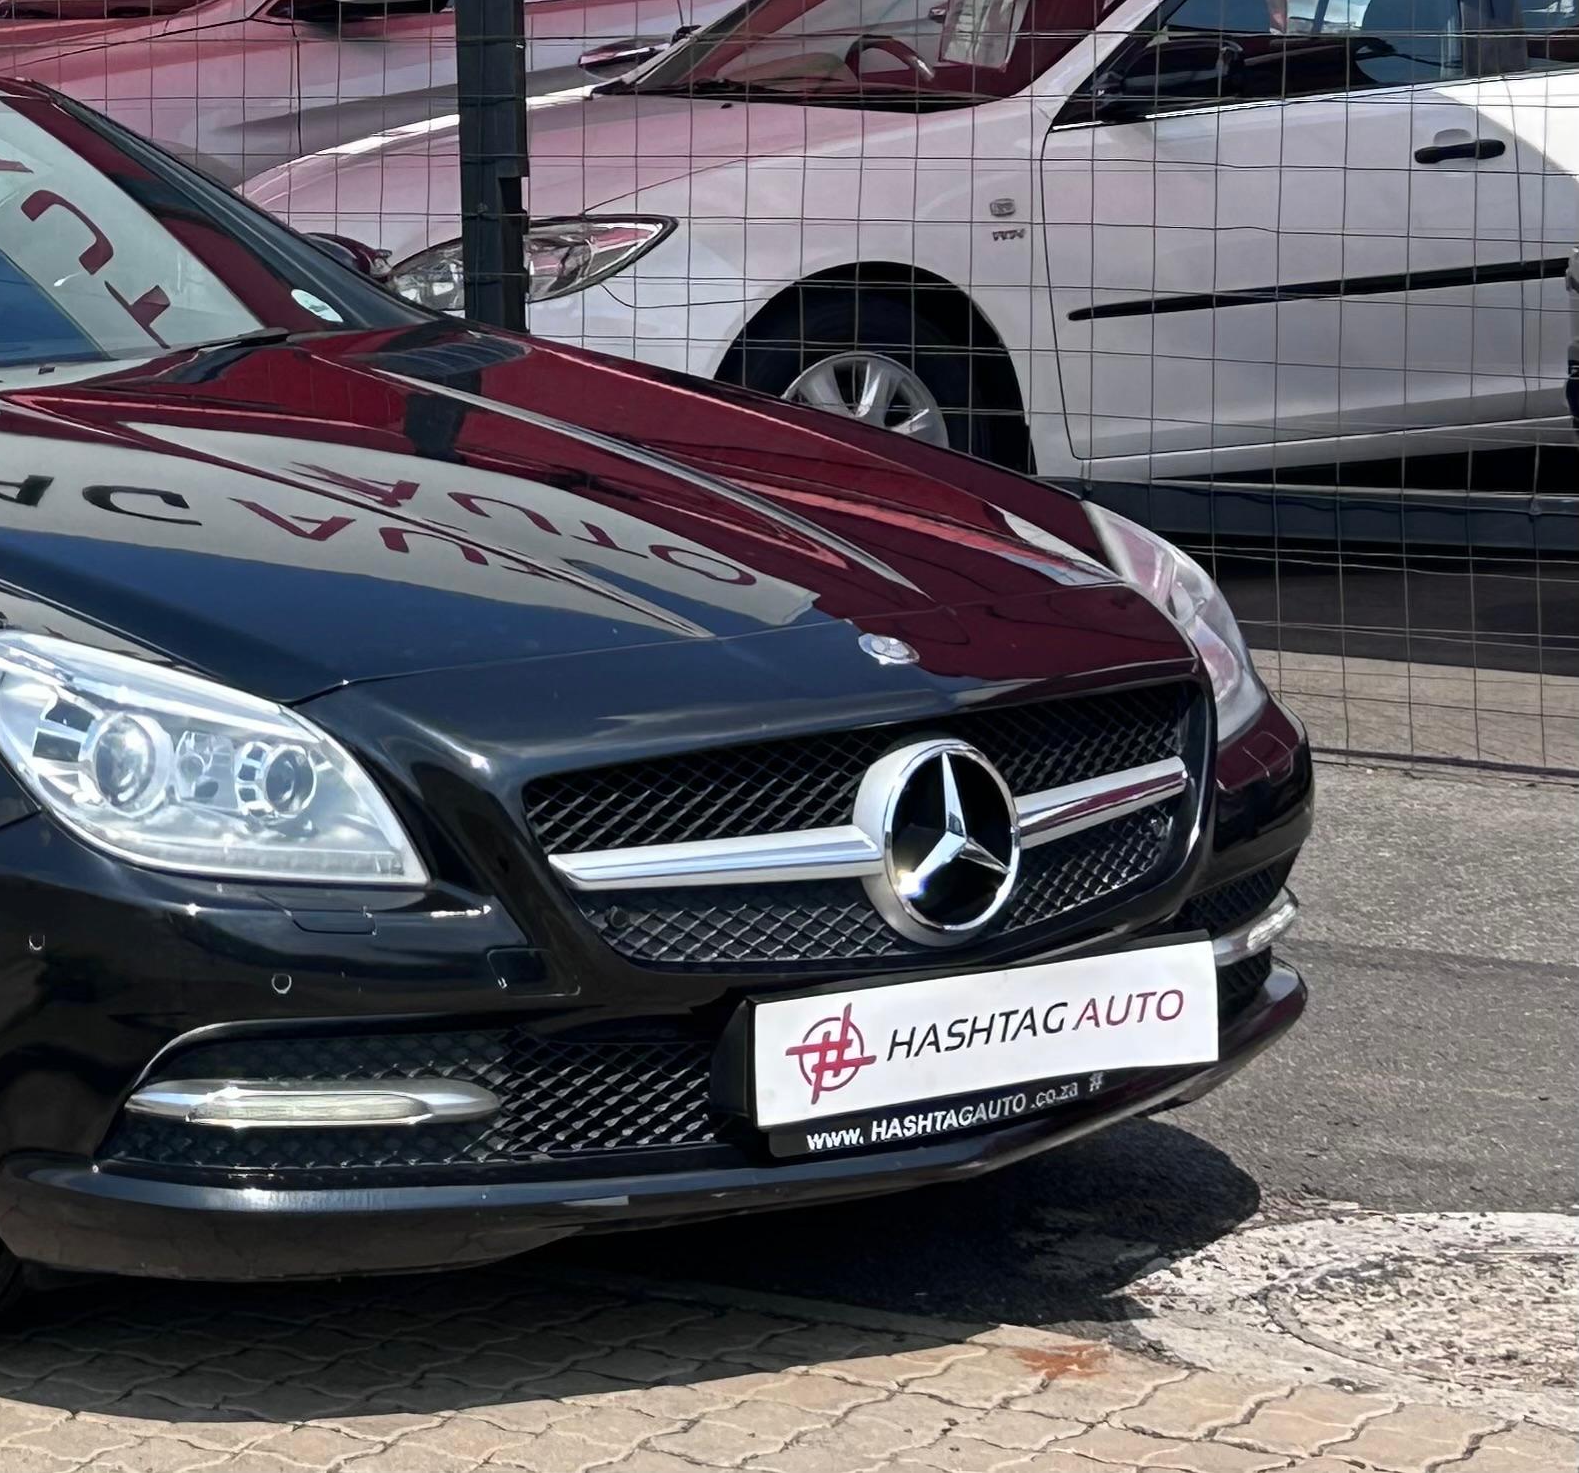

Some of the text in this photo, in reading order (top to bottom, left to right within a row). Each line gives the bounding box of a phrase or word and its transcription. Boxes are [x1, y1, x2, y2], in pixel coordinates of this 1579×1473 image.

[886, 989, 1184, 1062] HASHTAG AUTO
[871, 1093, 1027, 1143] HASHTAGAUTO
